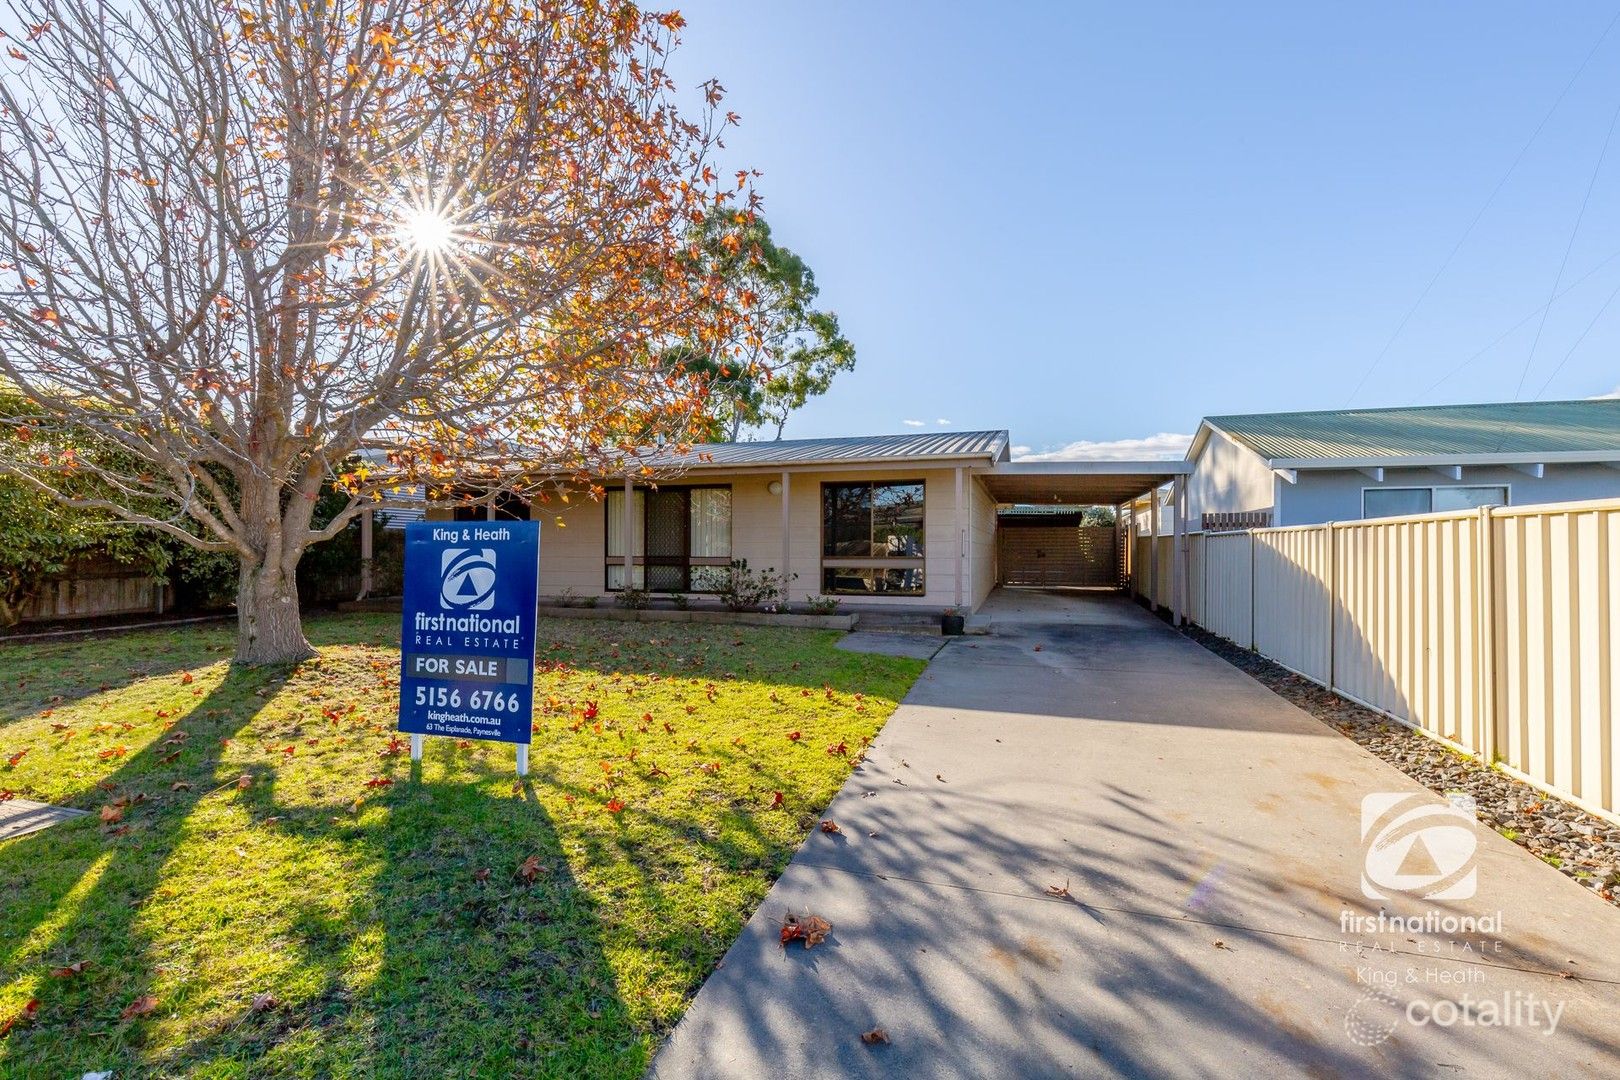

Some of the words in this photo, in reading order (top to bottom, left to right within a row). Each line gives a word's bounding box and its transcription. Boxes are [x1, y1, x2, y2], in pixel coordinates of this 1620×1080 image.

[433, 528, 459, 544] King
[462, 528, 471, 541] &
[474, 527, 510, 541] Heath
[415, 612, 520, 634] firstnational
[415, 635, 452, 646] REAL
[464, 637, 519, 650] ESTATE
[416, 657, 449, 674] FOR
[455, 660, 498, 676] SALE
[415, 686, 461, 708] 5156
[469, 690, 520, 713] 6766
[427, 710, 501, 726] kingheath.com.au
[434, 724, 445, 732] The
